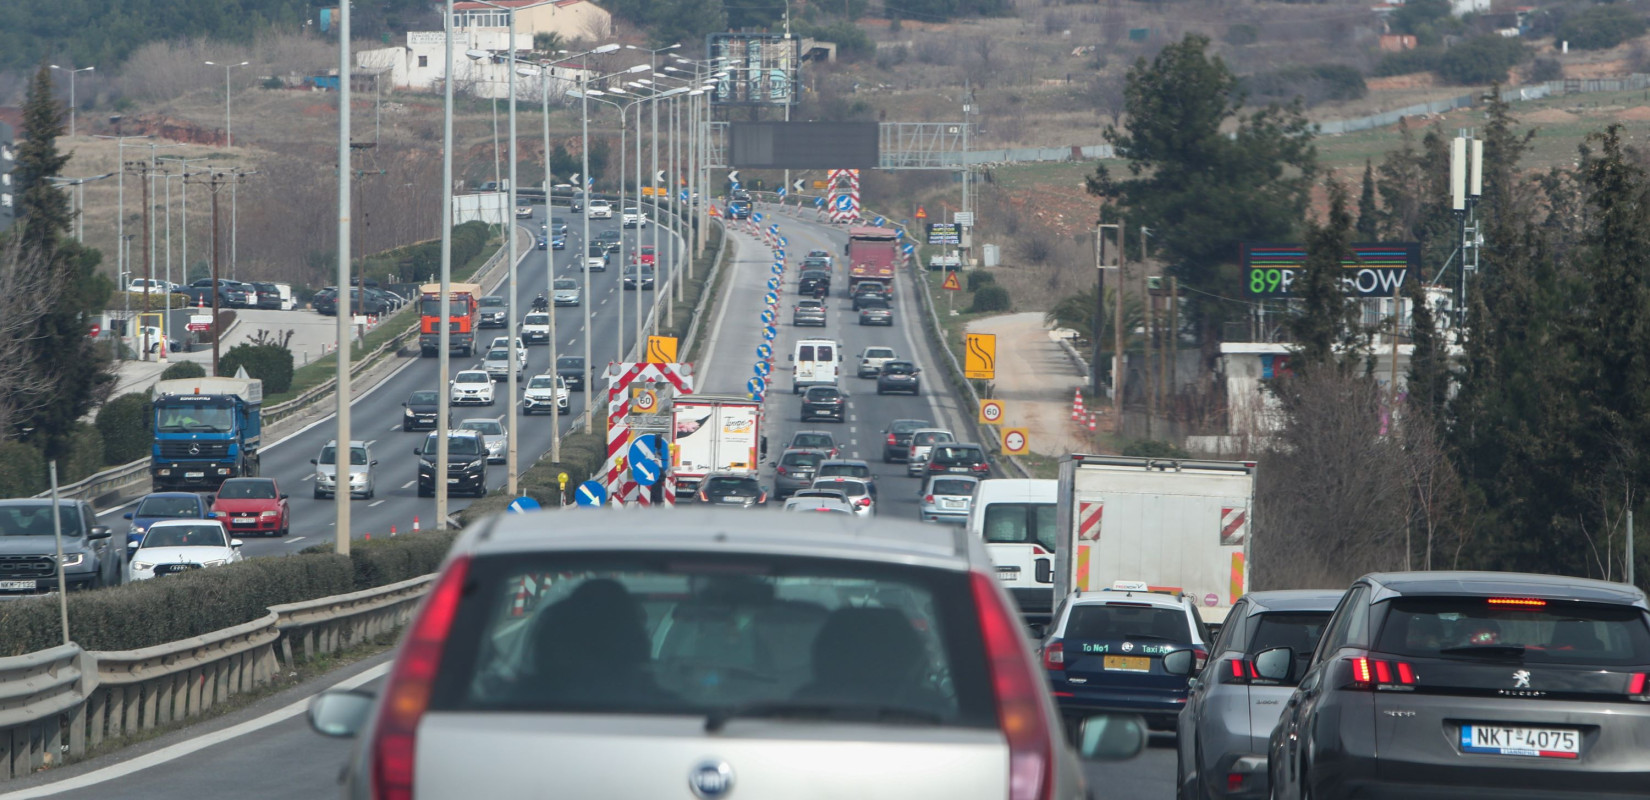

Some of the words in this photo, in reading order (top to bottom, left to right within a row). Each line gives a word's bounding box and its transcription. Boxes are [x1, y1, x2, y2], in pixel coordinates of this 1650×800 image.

[640, 397, 651, 405] 60
[986, 408, 998, 416] 60
[1083, 643, 1091, 652] To
[1093, 644, 1109, 652] No1
[1142, 644, 1158, 653] Taxi
[1477, 728, 1574, 750] NKT-4075
